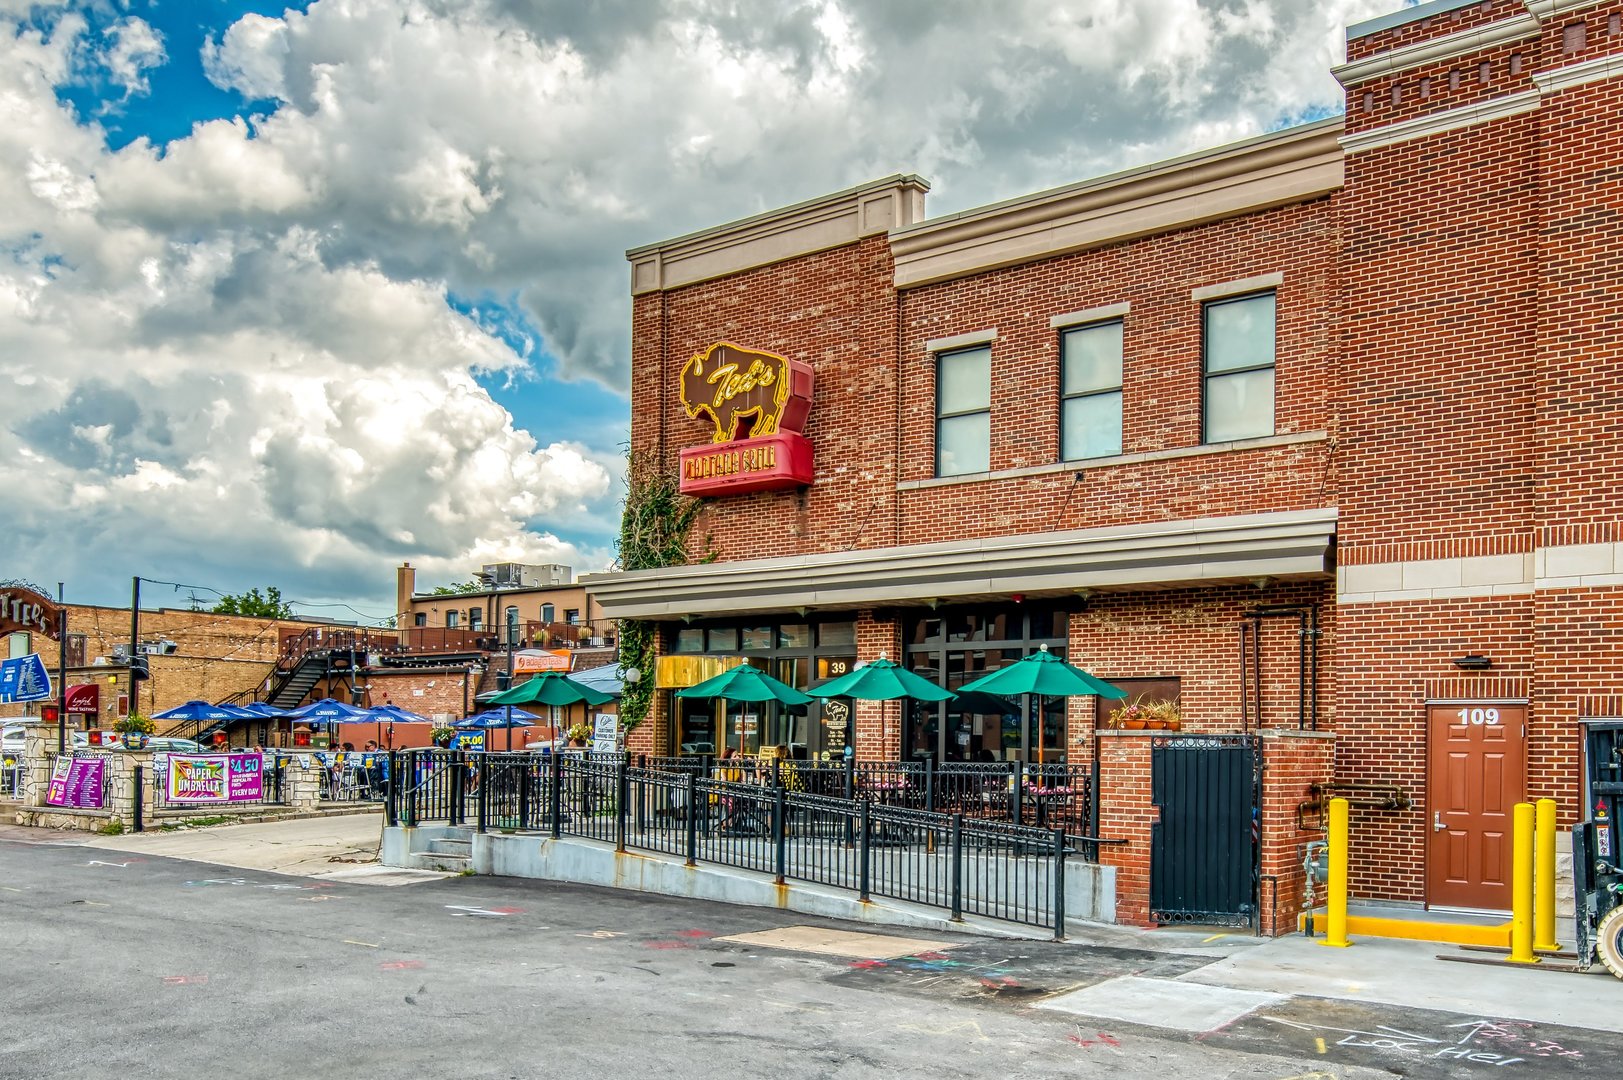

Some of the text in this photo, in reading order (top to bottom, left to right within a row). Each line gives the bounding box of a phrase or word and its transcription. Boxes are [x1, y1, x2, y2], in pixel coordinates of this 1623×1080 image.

[707, 360, 776, 407] Ted's
[742, 446, 776, 473] GRILL
[526, 657, 547, 668] adagio
[831, 662, 846, 673] 39
[1458, 708, 1499, 725] 109
[460, 735, 483, 746] $3.00
[231, 758, 259, 773] $4.50
[186, 768, 211, 780] PAPER
[178, 779, 220, 792] UMBRELLA
[232, 788, 248, 797] EVERY
